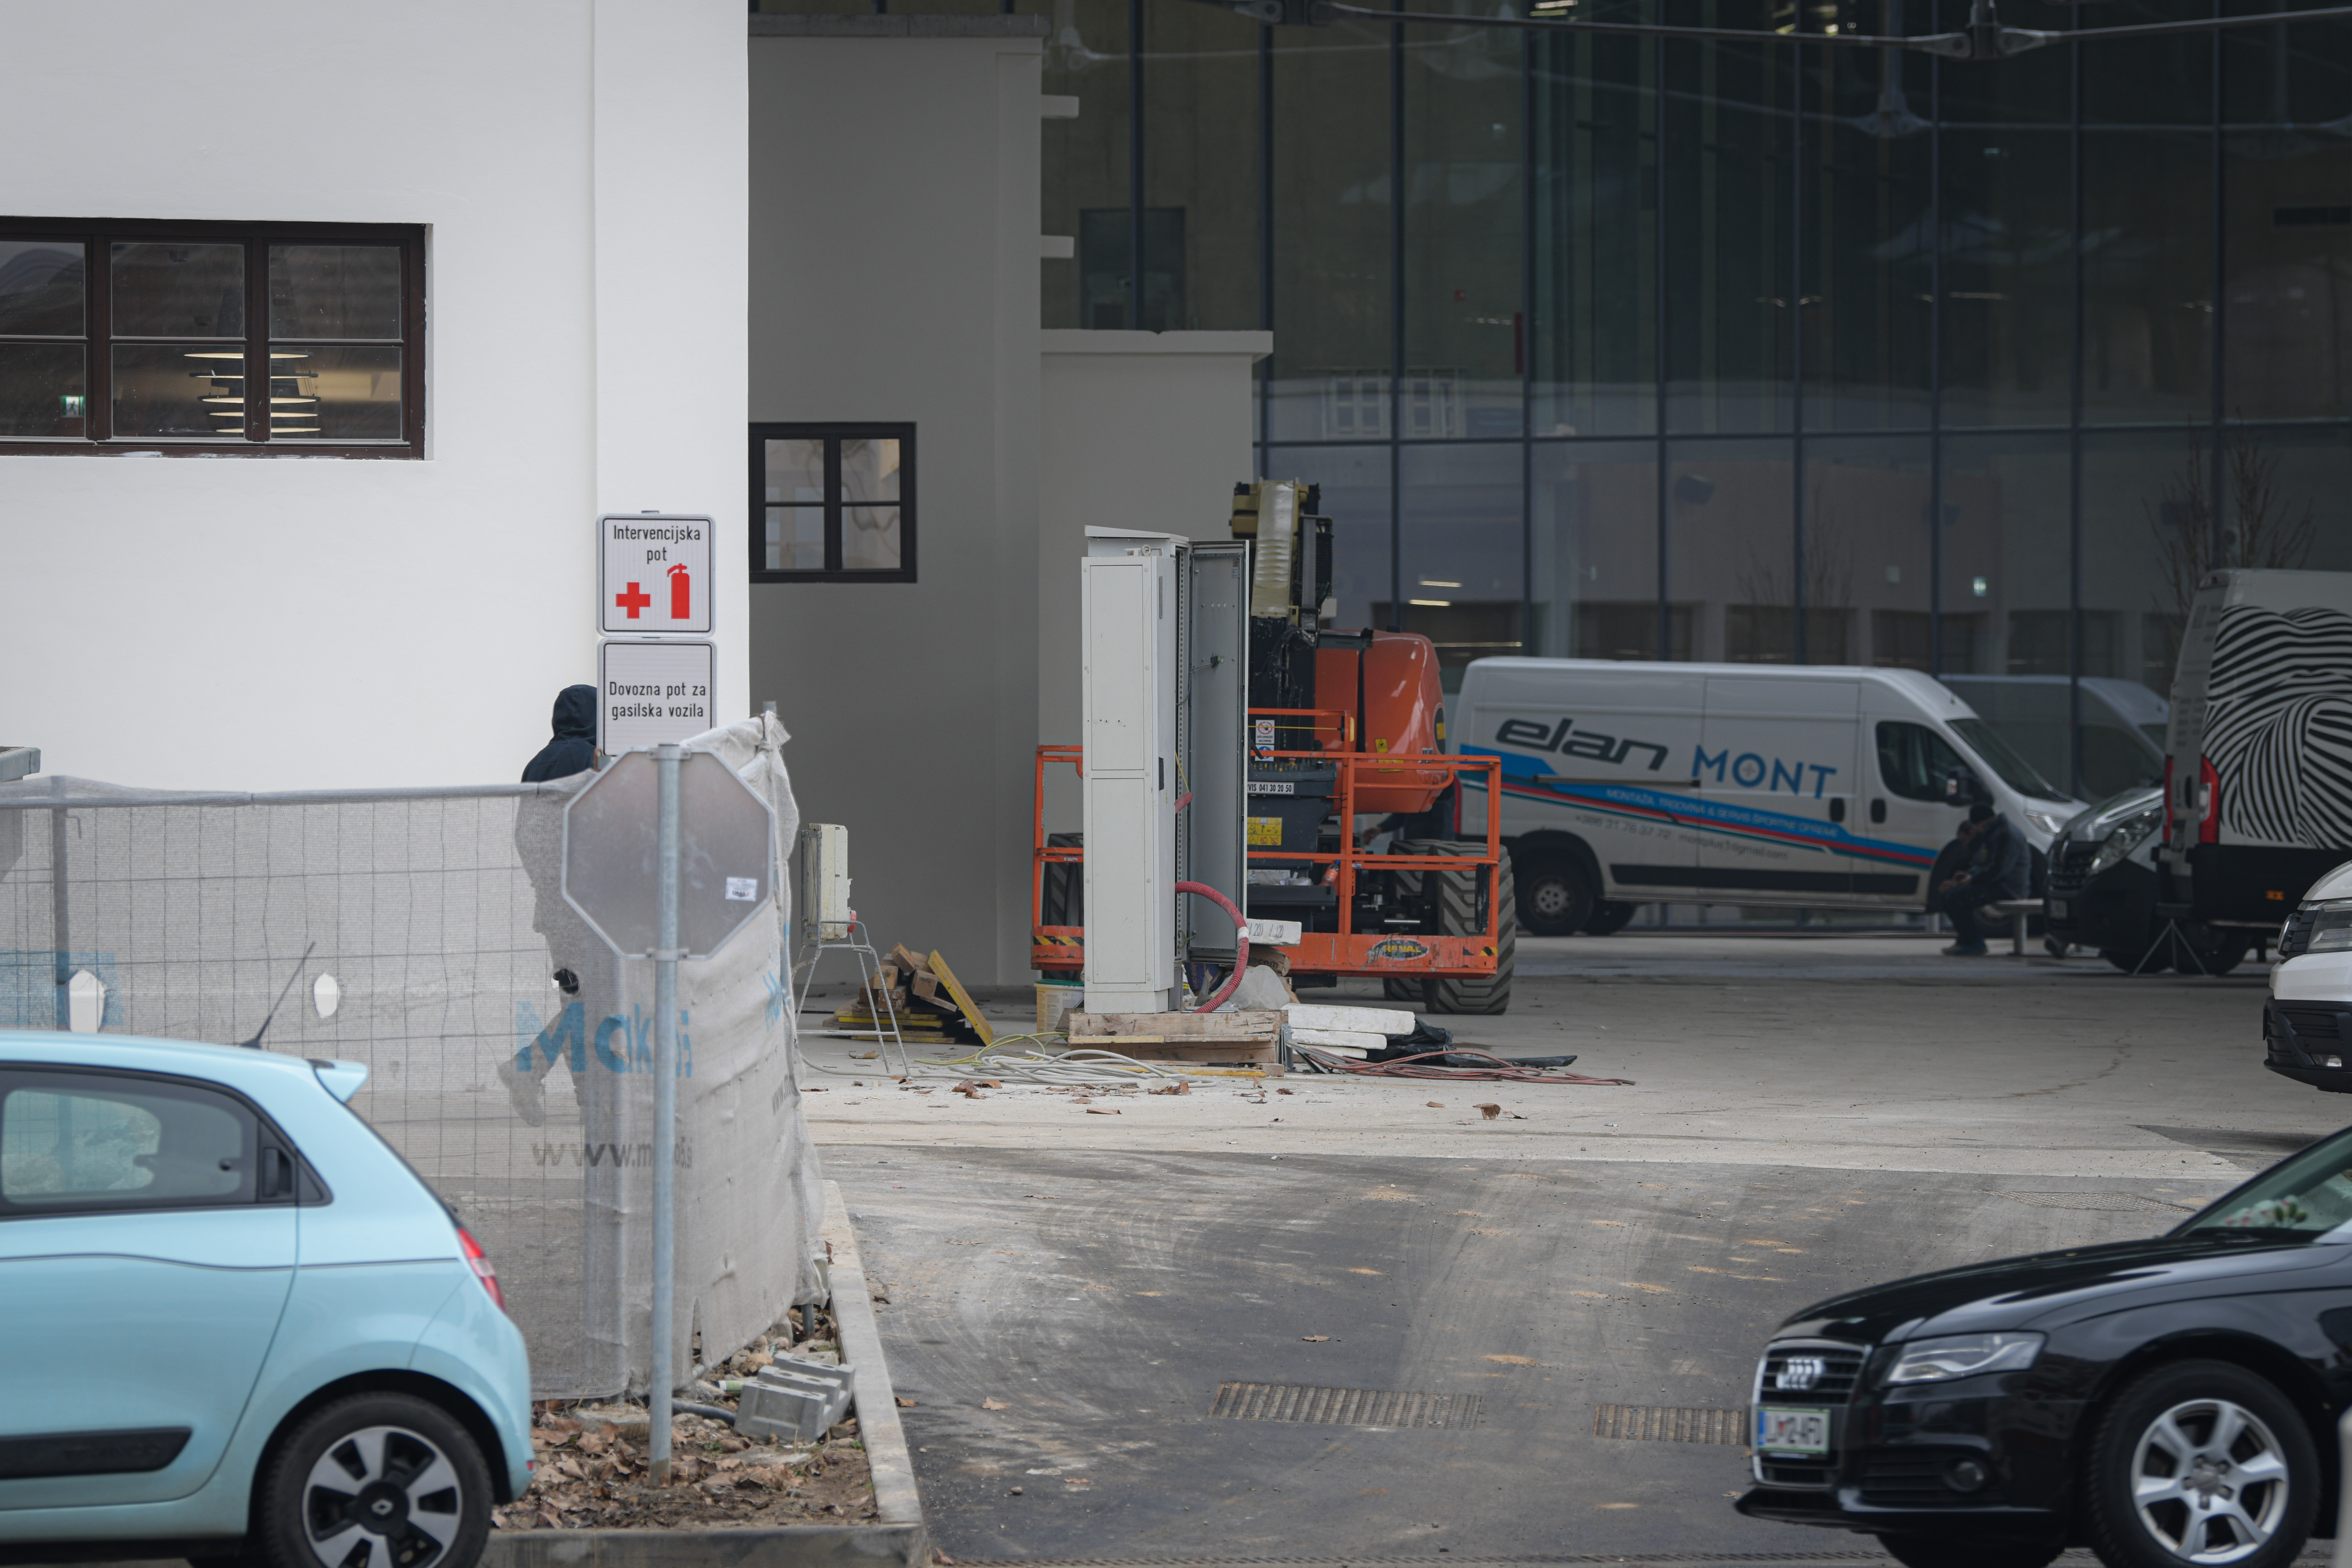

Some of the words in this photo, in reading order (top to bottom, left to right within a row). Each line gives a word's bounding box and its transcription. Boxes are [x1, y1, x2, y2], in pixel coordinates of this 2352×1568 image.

[614, 525, 700, 544] Intervencijska
[647, 548, 667, 564] pot
[609, 681, 660, 696] Dovozna
[666, 682, 685, 699] pot
[692, 683, 706, 696] za
[612, 703, 662, 720] gasilska
[669, 704, 704, 717] vozila
[1495, 718, 1669, 771] elan
[1692, 744, 1838, 800] MONT
[1247, 783, 1257, 792] VIS
[531, 1136, 693, 1169] www.mo5.si
